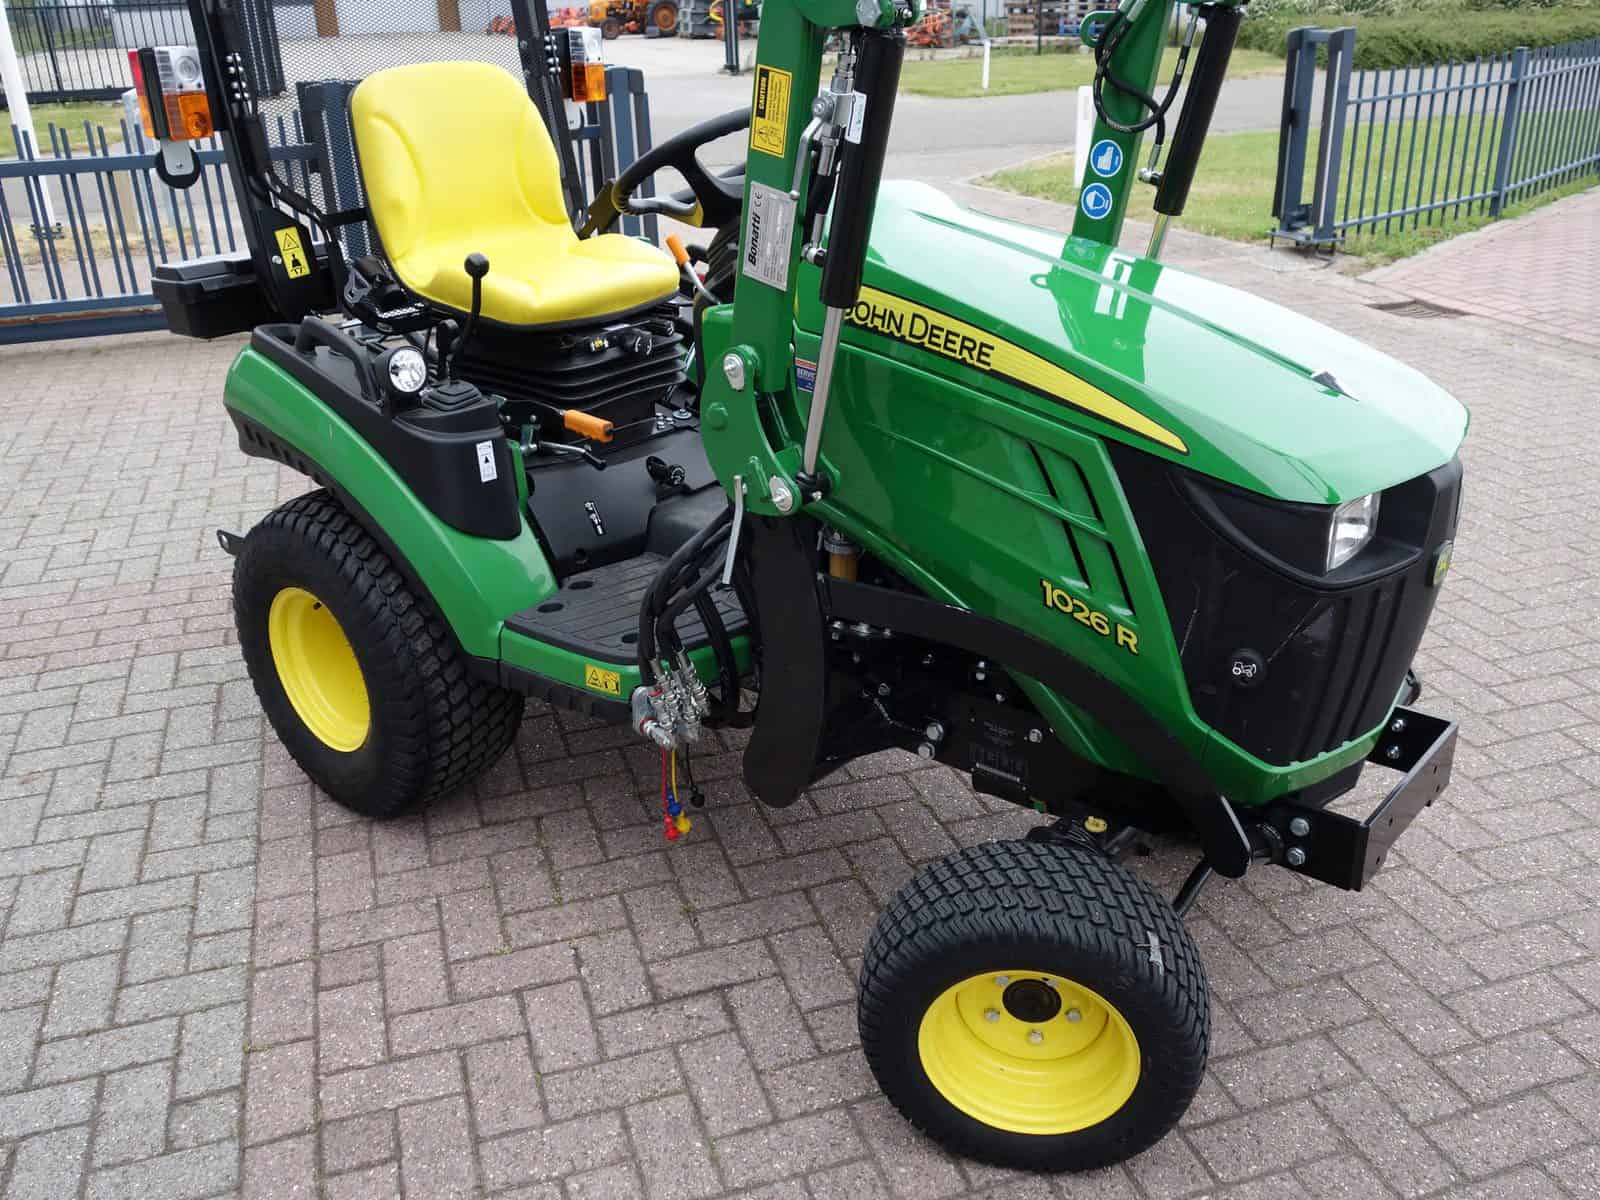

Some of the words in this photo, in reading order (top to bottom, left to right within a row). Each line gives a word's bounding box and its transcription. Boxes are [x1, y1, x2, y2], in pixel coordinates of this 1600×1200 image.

[758, 76, 767, 110] CAUTION
[748, 211, 761, 267] Bonatti
[908, 312, 995, 367] DEERE
[1040, 579, 1110, 636] 1026
[1116, 623, 1139, 656] R
